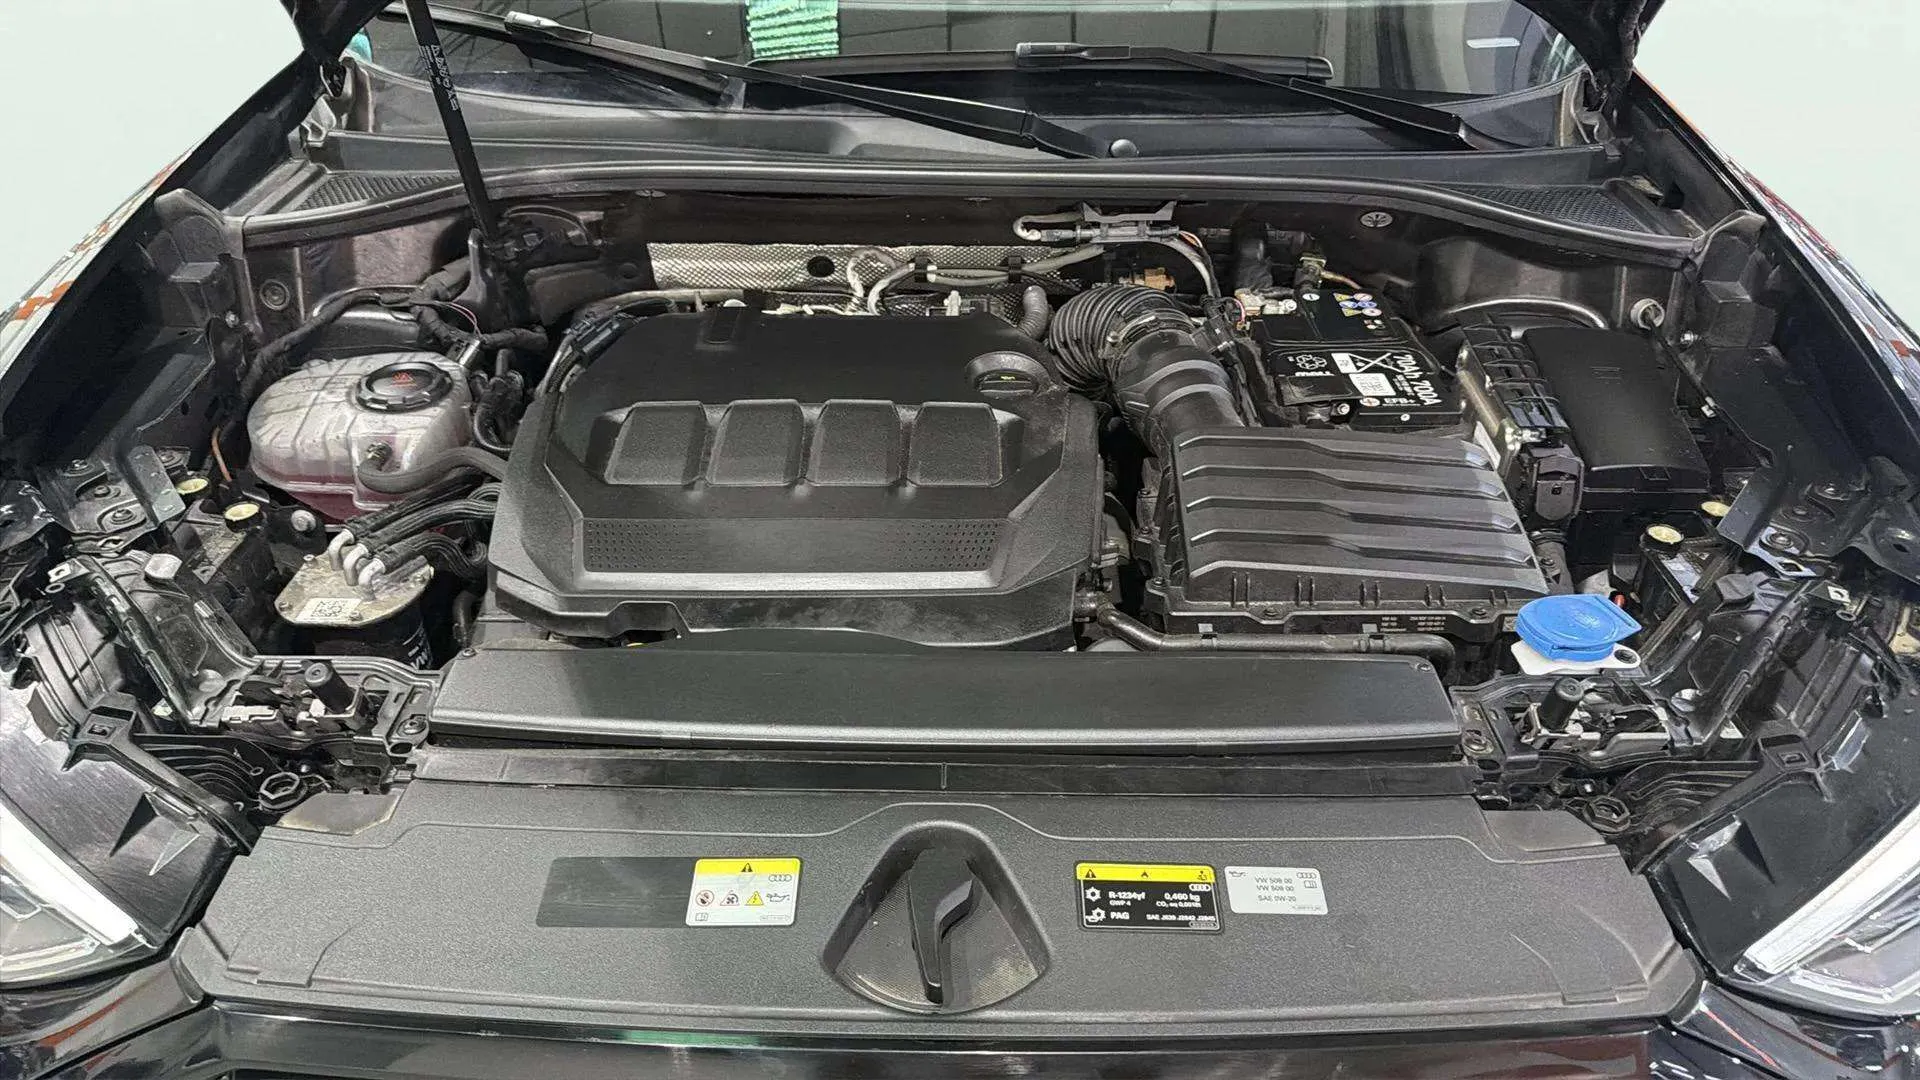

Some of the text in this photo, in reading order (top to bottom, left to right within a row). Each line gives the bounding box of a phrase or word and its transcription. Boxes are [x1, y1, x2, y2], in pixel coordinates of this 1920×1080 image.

[1393, 354, 1424, 379] 70Ah
[1410, 378, 1442, 406] 700A
[1108, 891, 1146, 900] R-1234yf
[1189, 893, 1201, 902] kg
[1110, 911, 1130, 920] PAG
